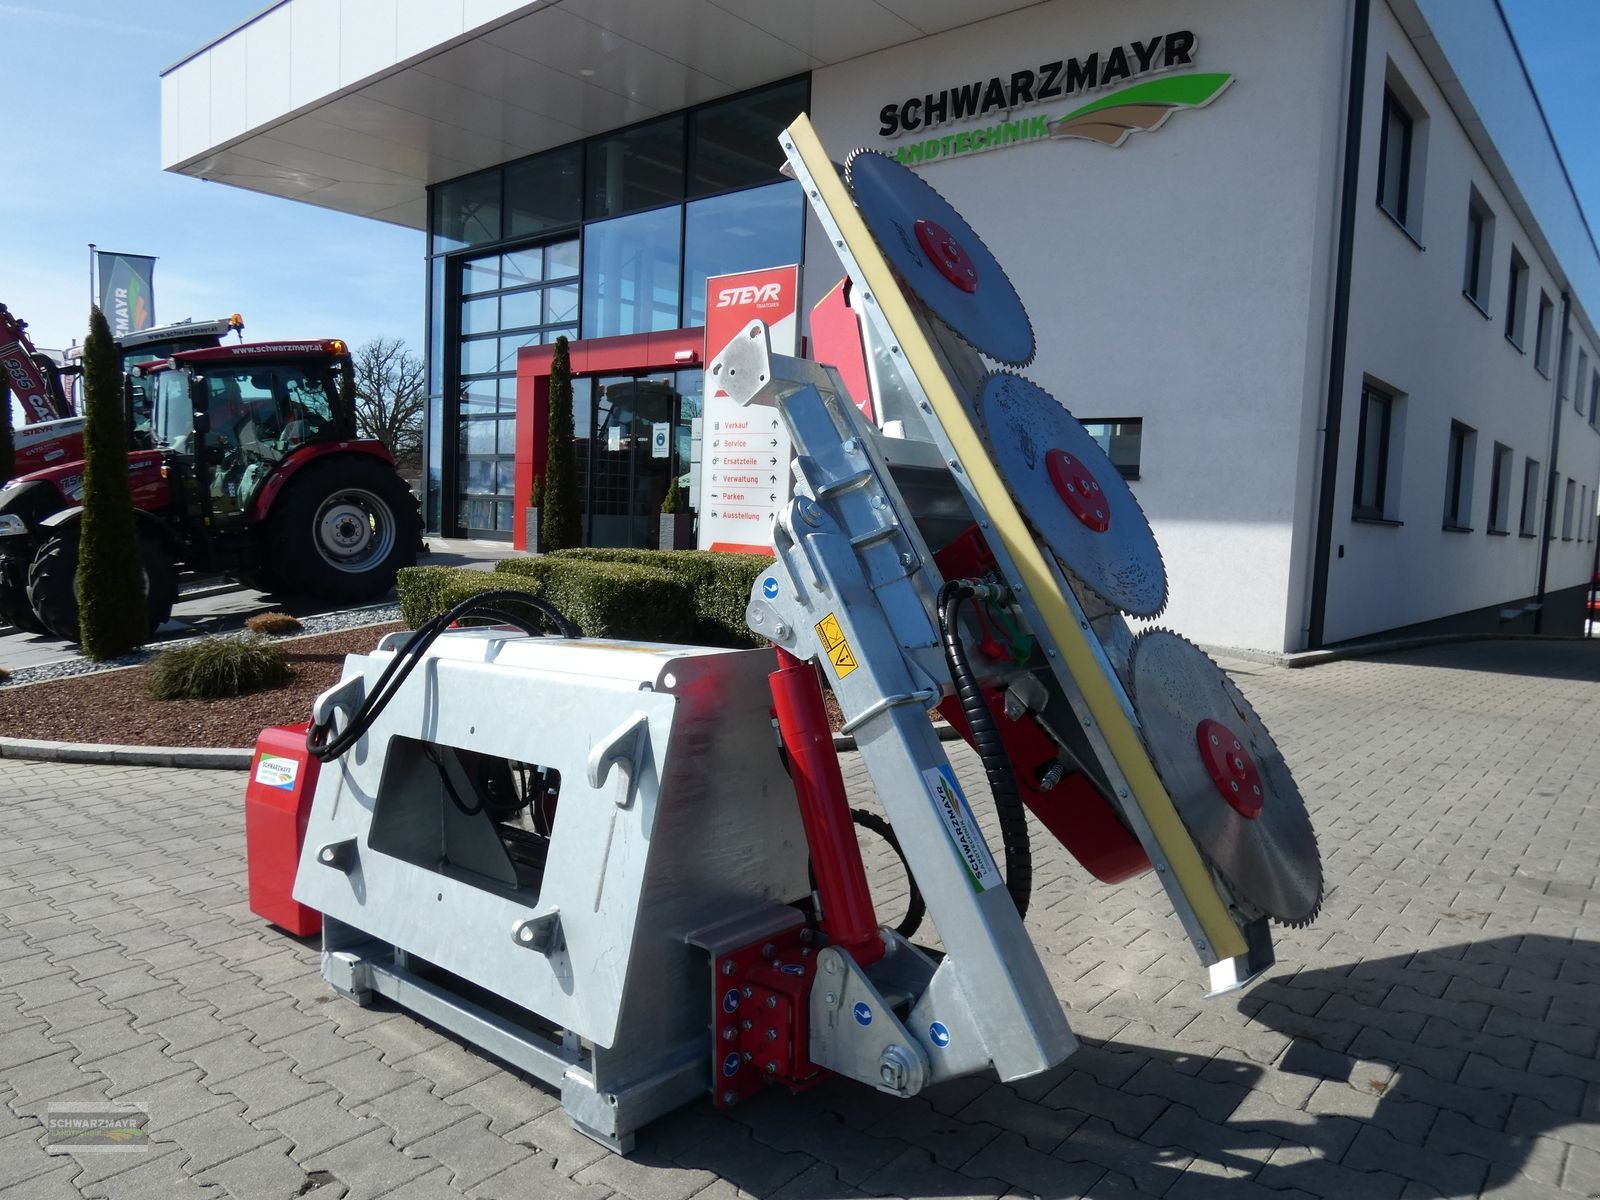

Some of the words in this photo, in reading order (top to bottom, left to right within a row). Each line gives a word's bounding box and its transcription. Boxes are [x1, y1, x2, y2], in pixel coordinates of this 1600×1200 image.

[879, 30, 1196, 136] SCHWARZMAYR
[894, 114, 1048, 164] ANDTECHNIK
[716, 283, 781, 308] STEYR
[147, 326, 218, 340] www.schwarzmayr.at
[232, 344, 323, 355] www.schwarzmayr.at
[4, 358, 36, 390] 935
[23, 425, 53, 437] STEYR
[724, 421, 749, 429] Verkauf
[723, 457, 758, 465] Ersatzteile
[723, 475, 759, 484] Verwaltung
[722, 512, 760, 521] Ausstellung
[936, 786, 983, 880] SCHWARZMAYR
[960, 820, 988, 875] LANDTECHNIK
